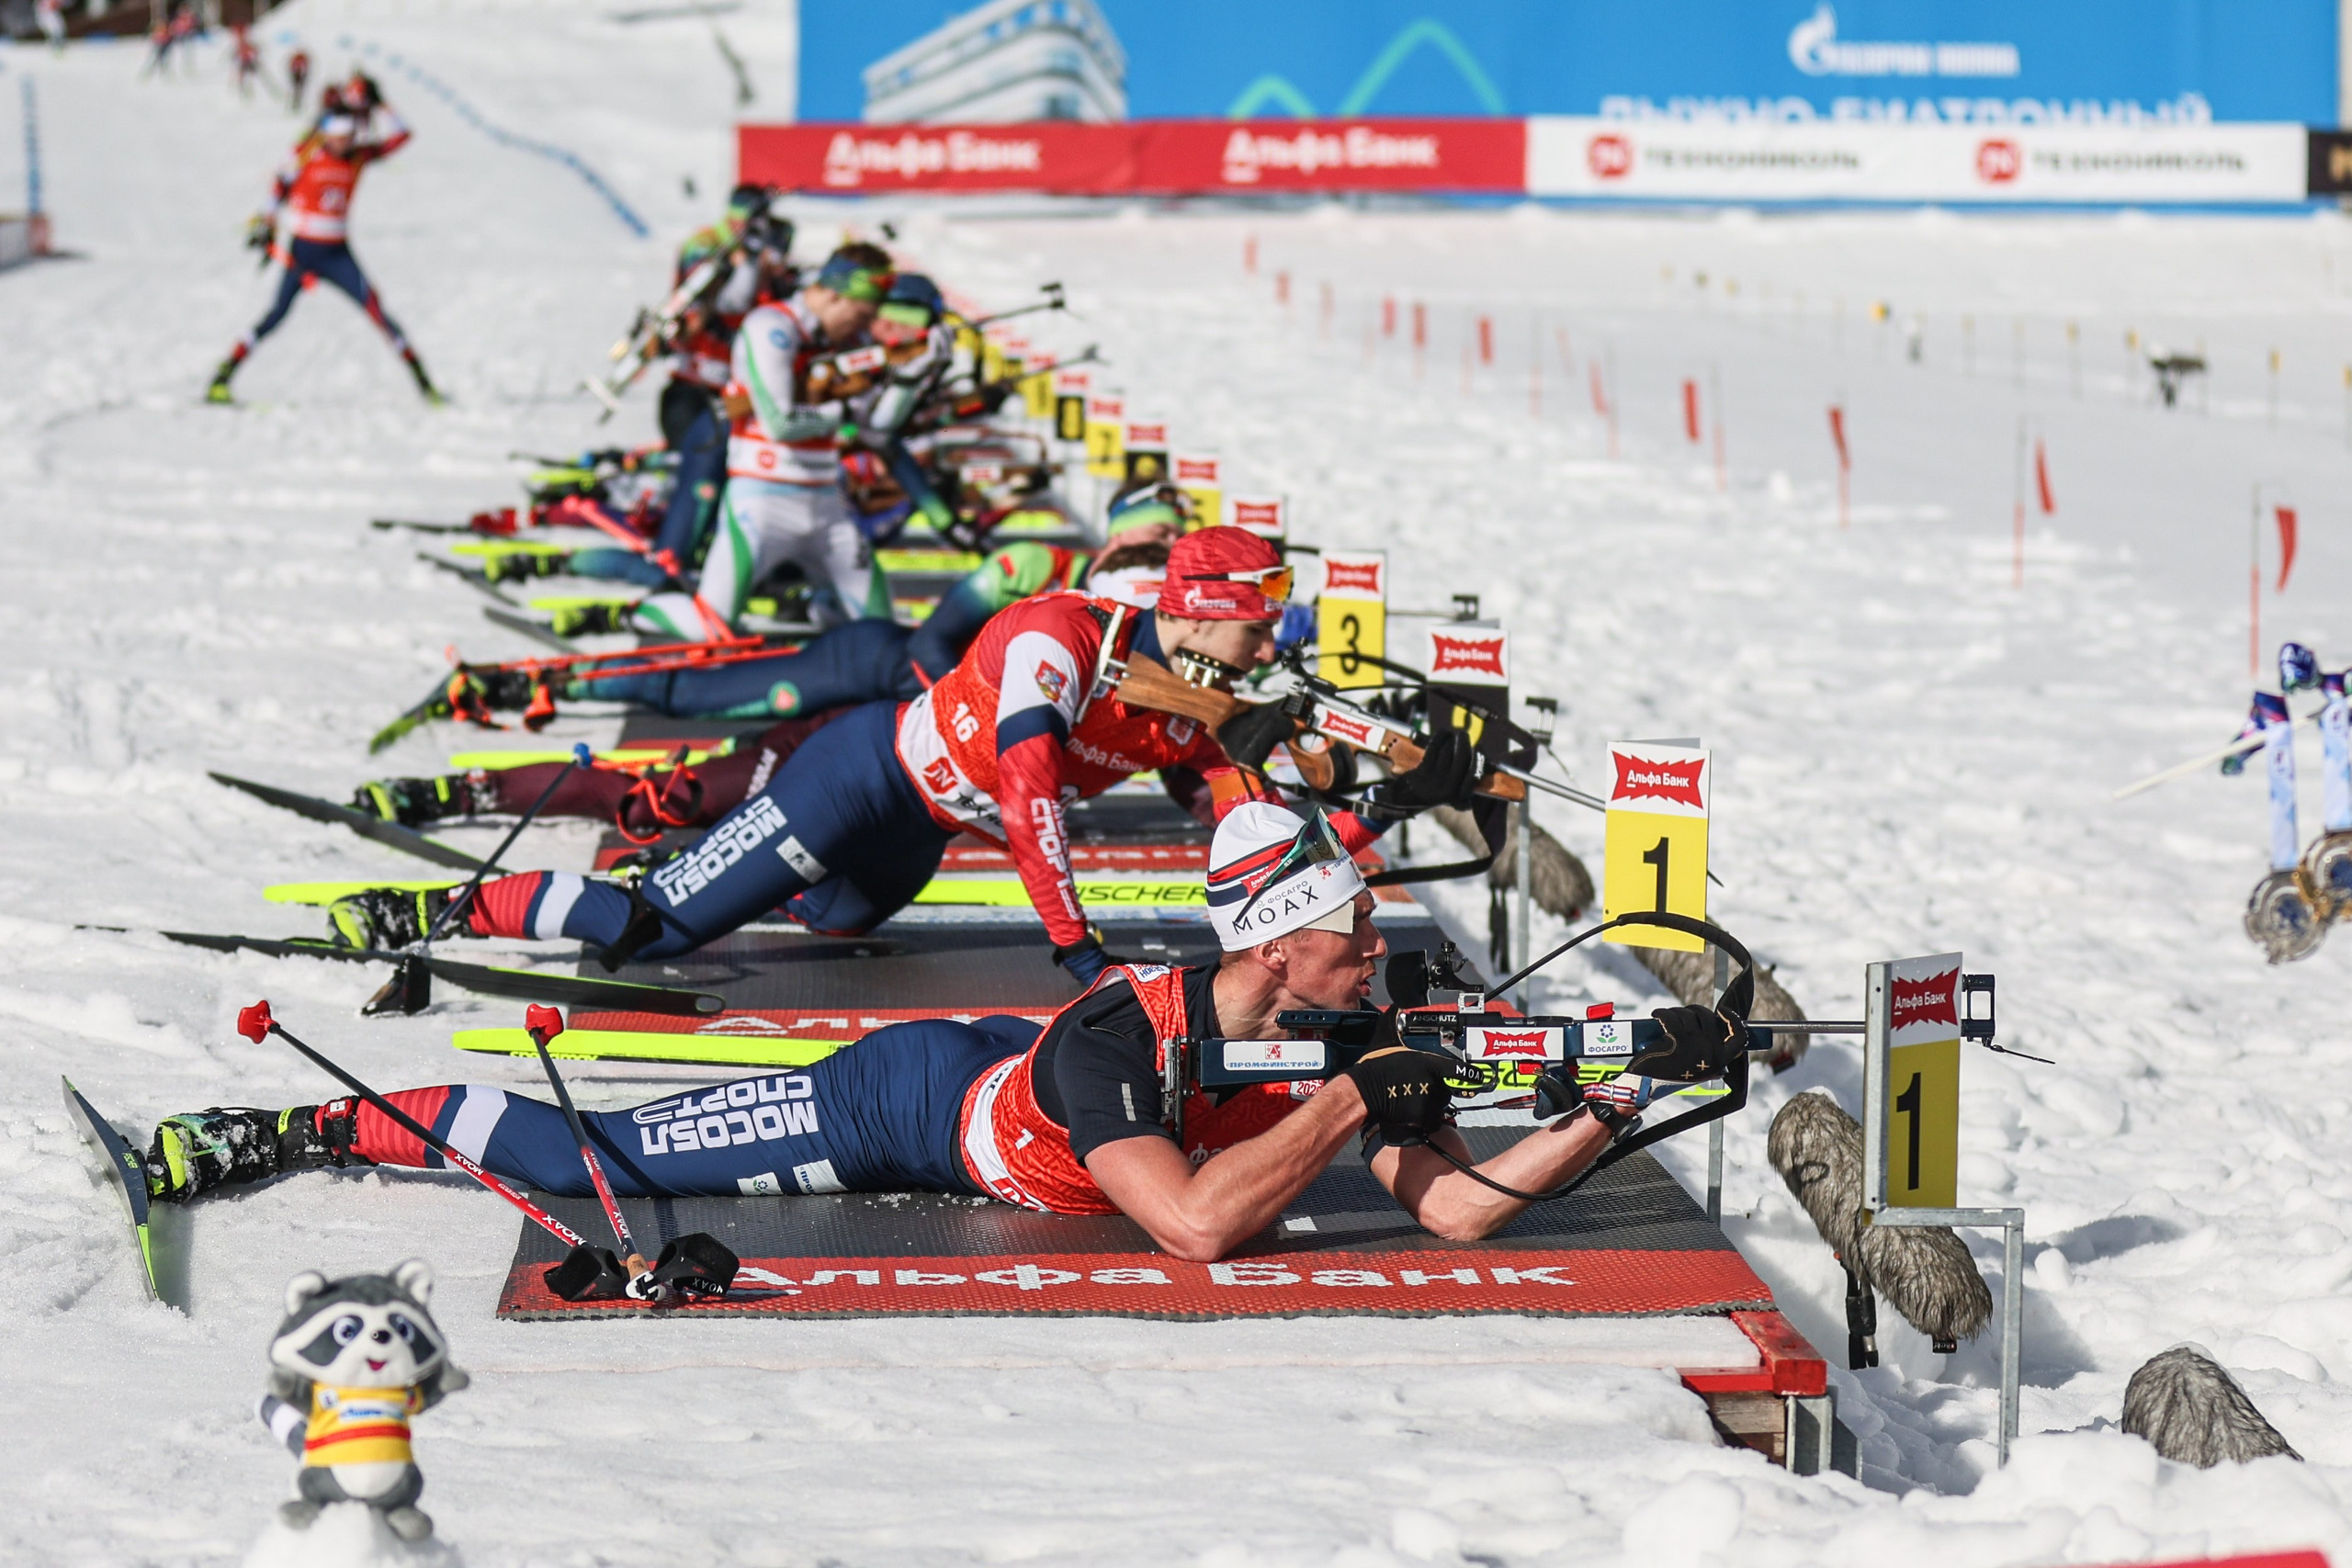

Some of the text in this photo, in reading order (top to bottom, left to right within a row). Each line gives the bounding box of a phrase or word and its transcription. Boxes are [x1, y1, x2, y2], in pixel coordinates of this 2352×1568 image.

[1340, 614, 1361, 675] 3
[1443, 647, 1493, 663] Альфа Банк
[951, 703, 980, 742] 16
[1067, 737, 1108, 765] льфа
[1626, 769, 1690, 788] Альфа Банк
[1077, 885, 1206, 901] ISCHER
[1267, 880, 1308, 905] ФОСАГРО
[1643, 836, 1669, 929] 1
[1232, 885, 1319, 936] MOAX
[1894, 990, 1946, 1016] Альфа Банк
[1492, 1039, 1518, 1050] Альфа
[1588, 1044, 1627, 1054] ФОСАГРО
[1455, 1065, 1484, 1081] MOA
[681, 1075, 814, 1115] СПОРТ
[1296, 1081, 1322, 1097] 202
[1014, 1128, 1035, 1151] 1
[1896, 1072, 1921, 1191] 1
[454, 1153, 484, 1176] MOAX
[542, 1213, 587, 1247] MOAX
[1208, 1262, 1574, 1288] Банк
